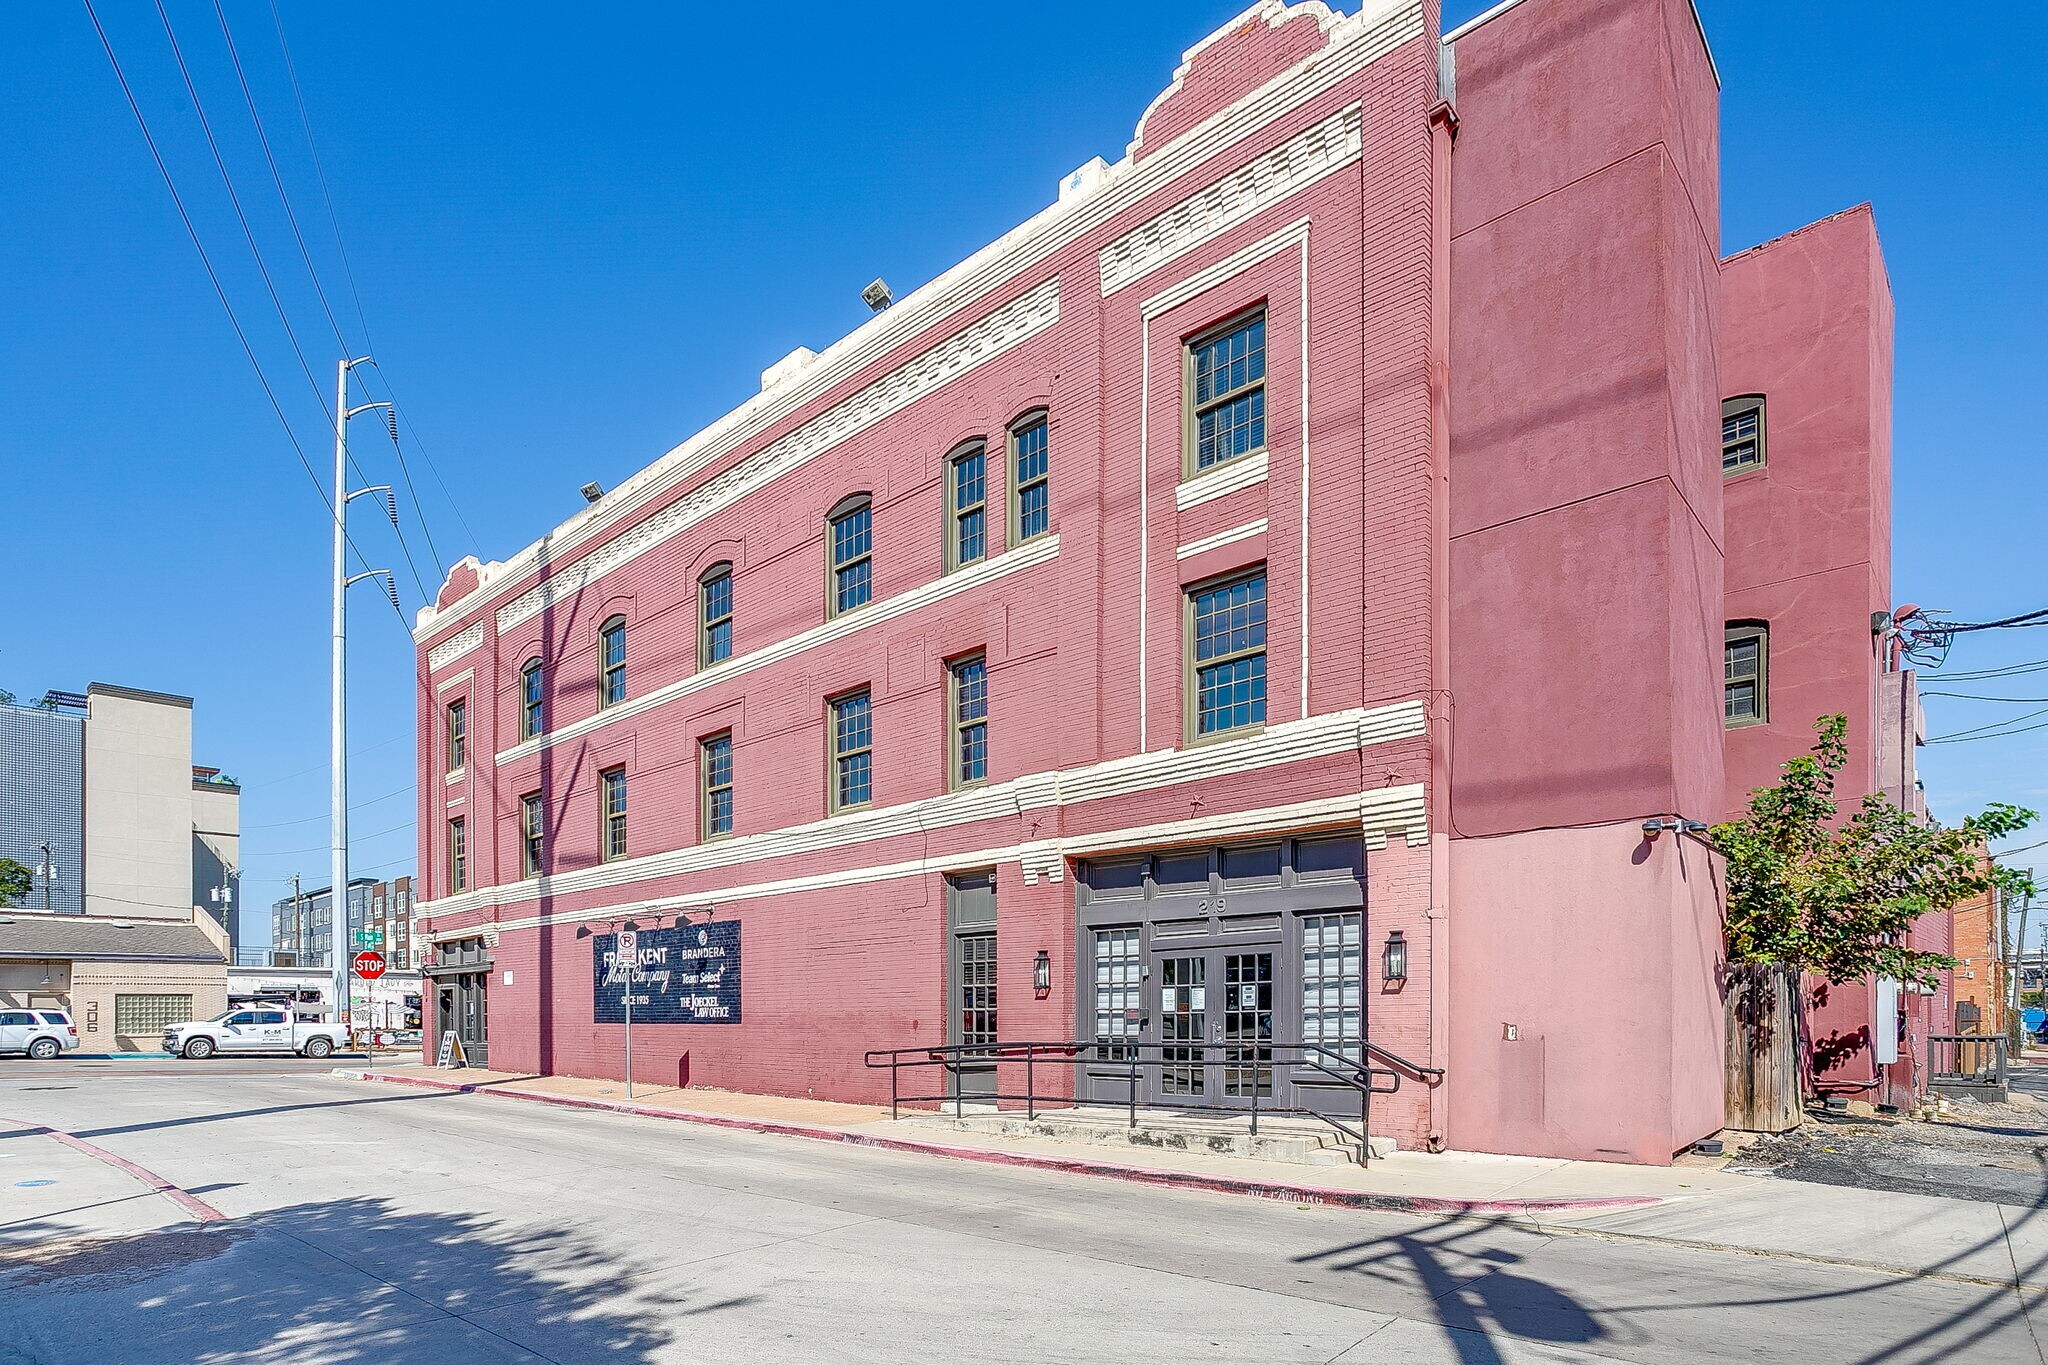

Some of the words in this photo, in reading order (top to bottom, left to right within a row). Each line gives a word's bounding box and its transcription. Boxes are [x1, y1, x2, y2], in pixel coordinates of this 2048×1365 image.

[1199, 899, 1226, 915] 219
[638, 947, 668, 965] KENT
[682, 946, 726, 960] BRANDERA
[356, 959, 385, 972] STOP
[602, 965, 631, 987] Moto
[631, 963, 670, 994] Company
[682, 972, 699, 984] Team
[700, 971, 720, 983] Select
[621, 995, 636, 1005] SICE
[680, 997, 691, 1008] THE
[694, 1006, 708, 1018] LAW
[708, 1006, 729, 1018] OFFICE
